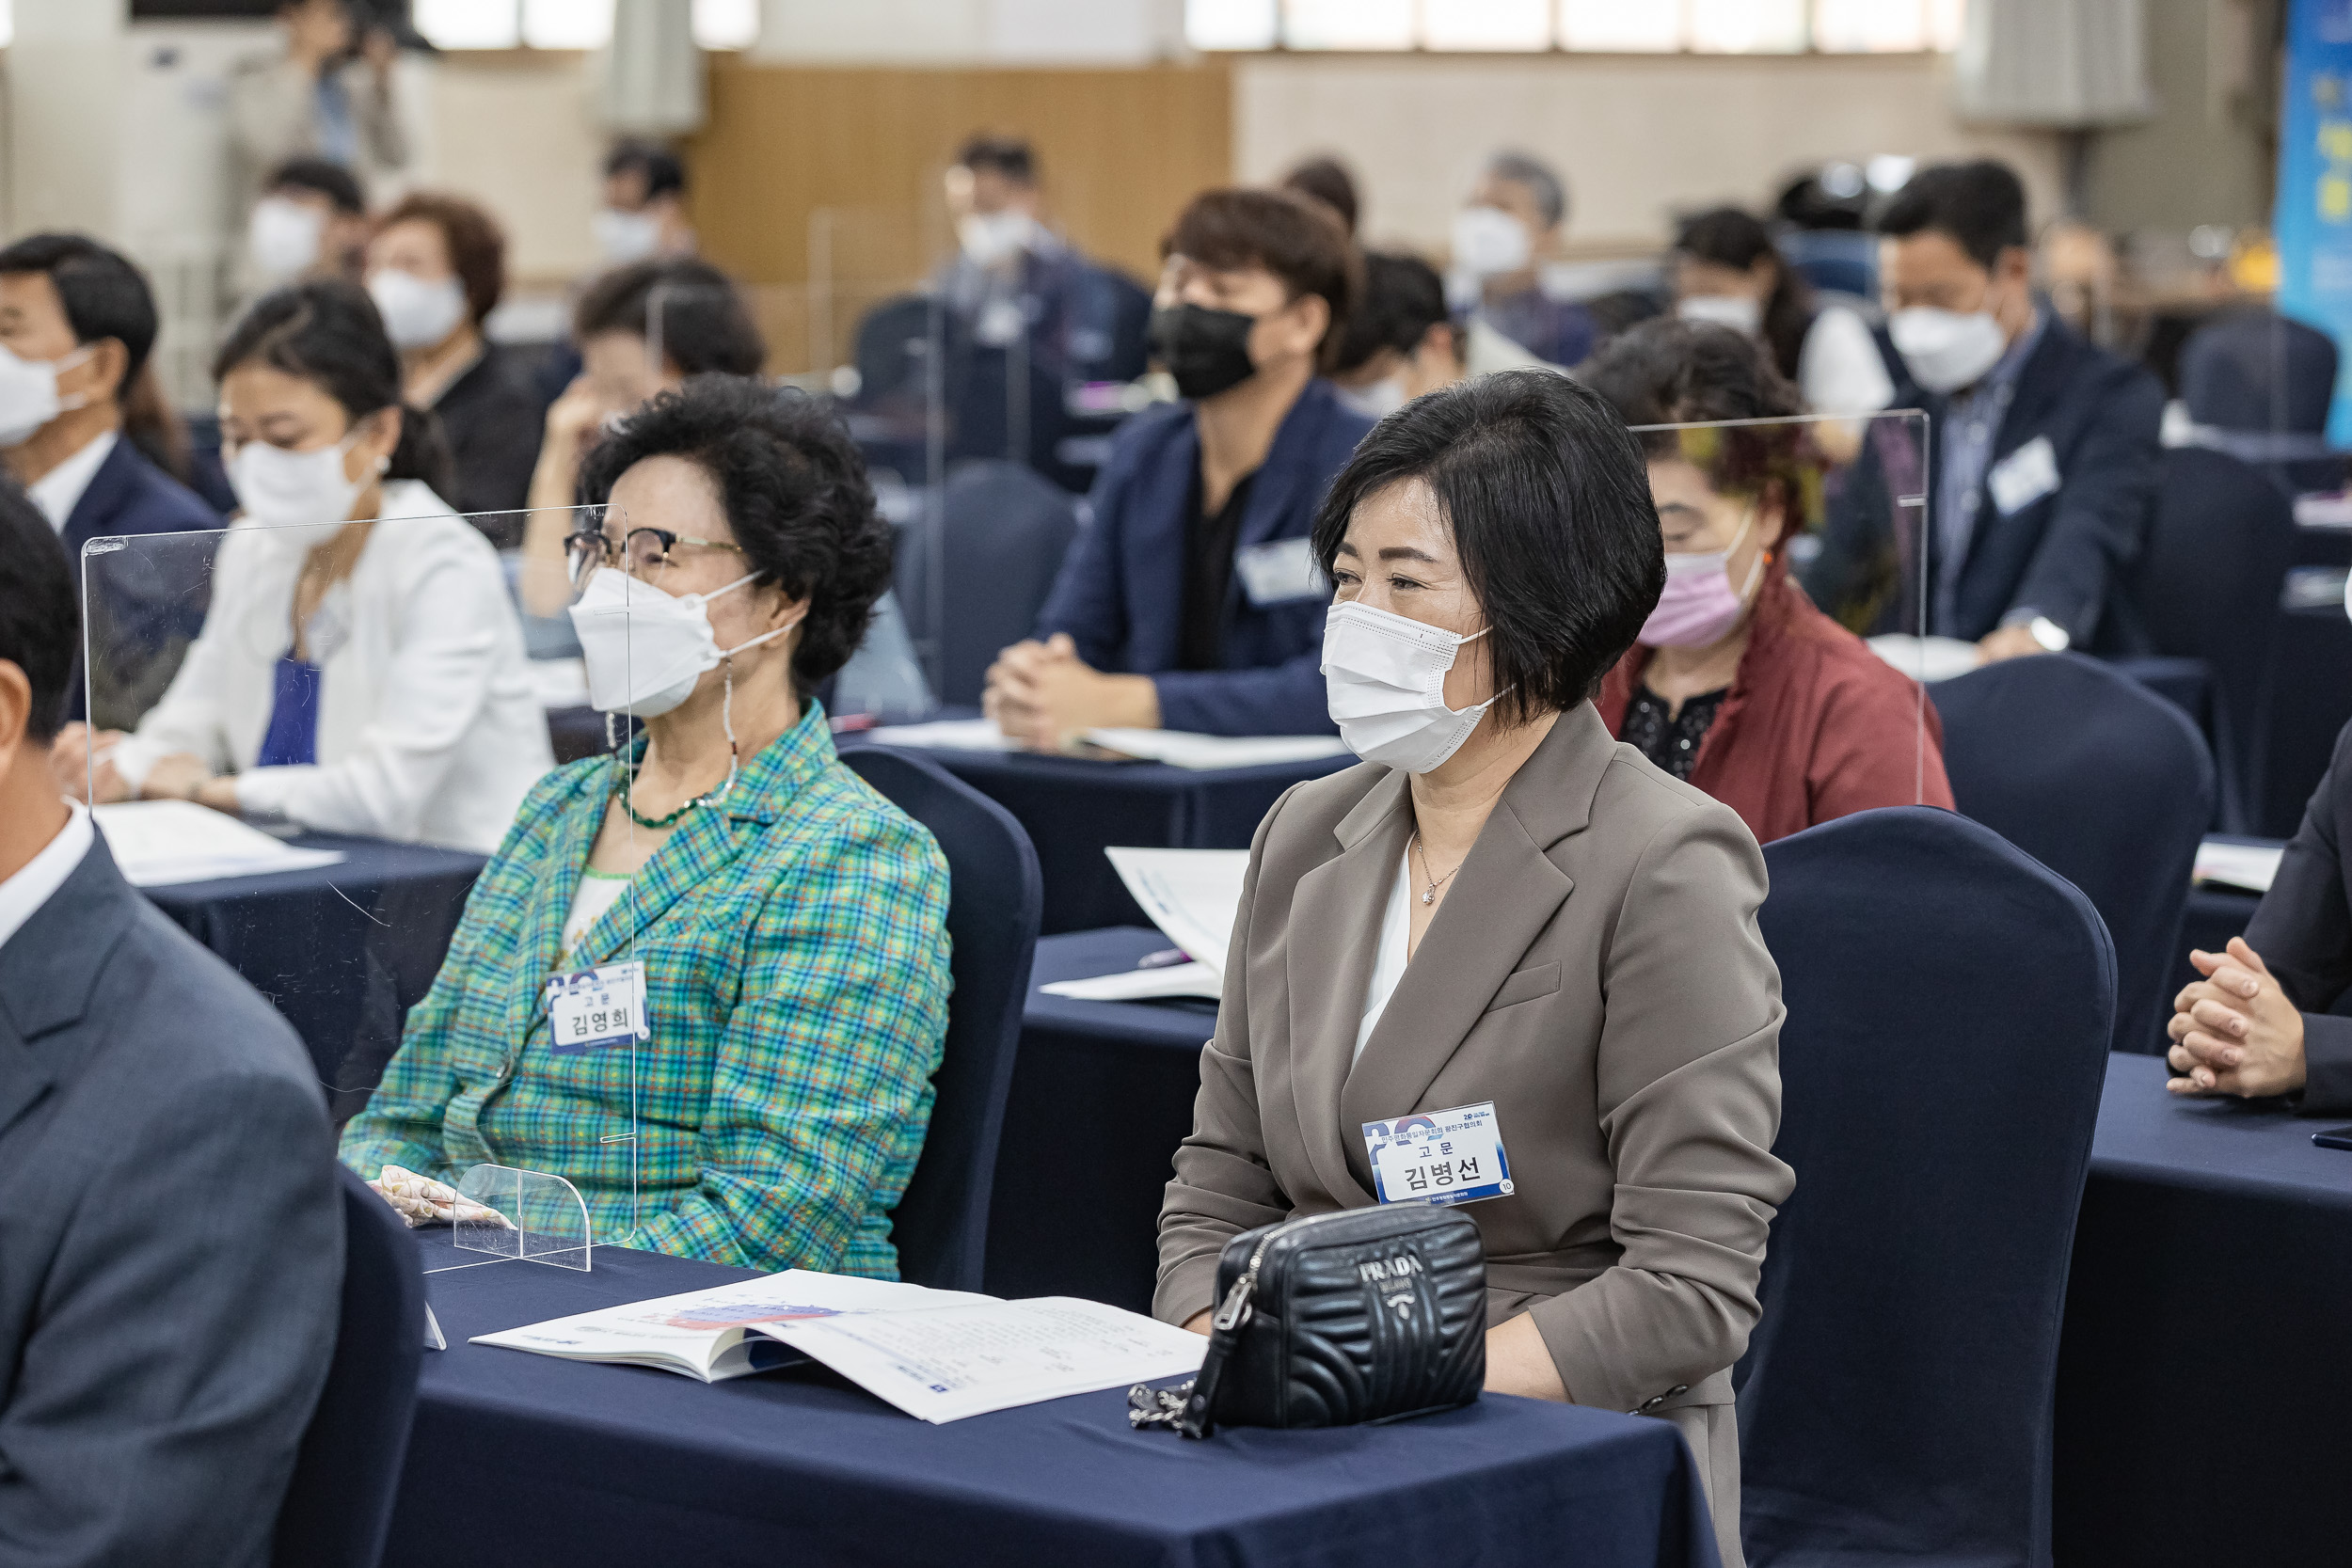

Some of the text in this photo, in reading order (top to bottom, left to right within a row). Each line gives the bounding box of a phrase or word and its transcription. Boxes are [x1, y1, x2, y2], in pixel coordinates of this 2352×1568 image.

[572, 1007, 628, 1036] 김영희
[1444, 1119, 1483, 1133] 광진구협의회
[1404, 1156, 1482, 1192] 김병선
[1502, 1181, 1512, 1191] 10
[1359, 1254, 1423, 1282] PRADA
